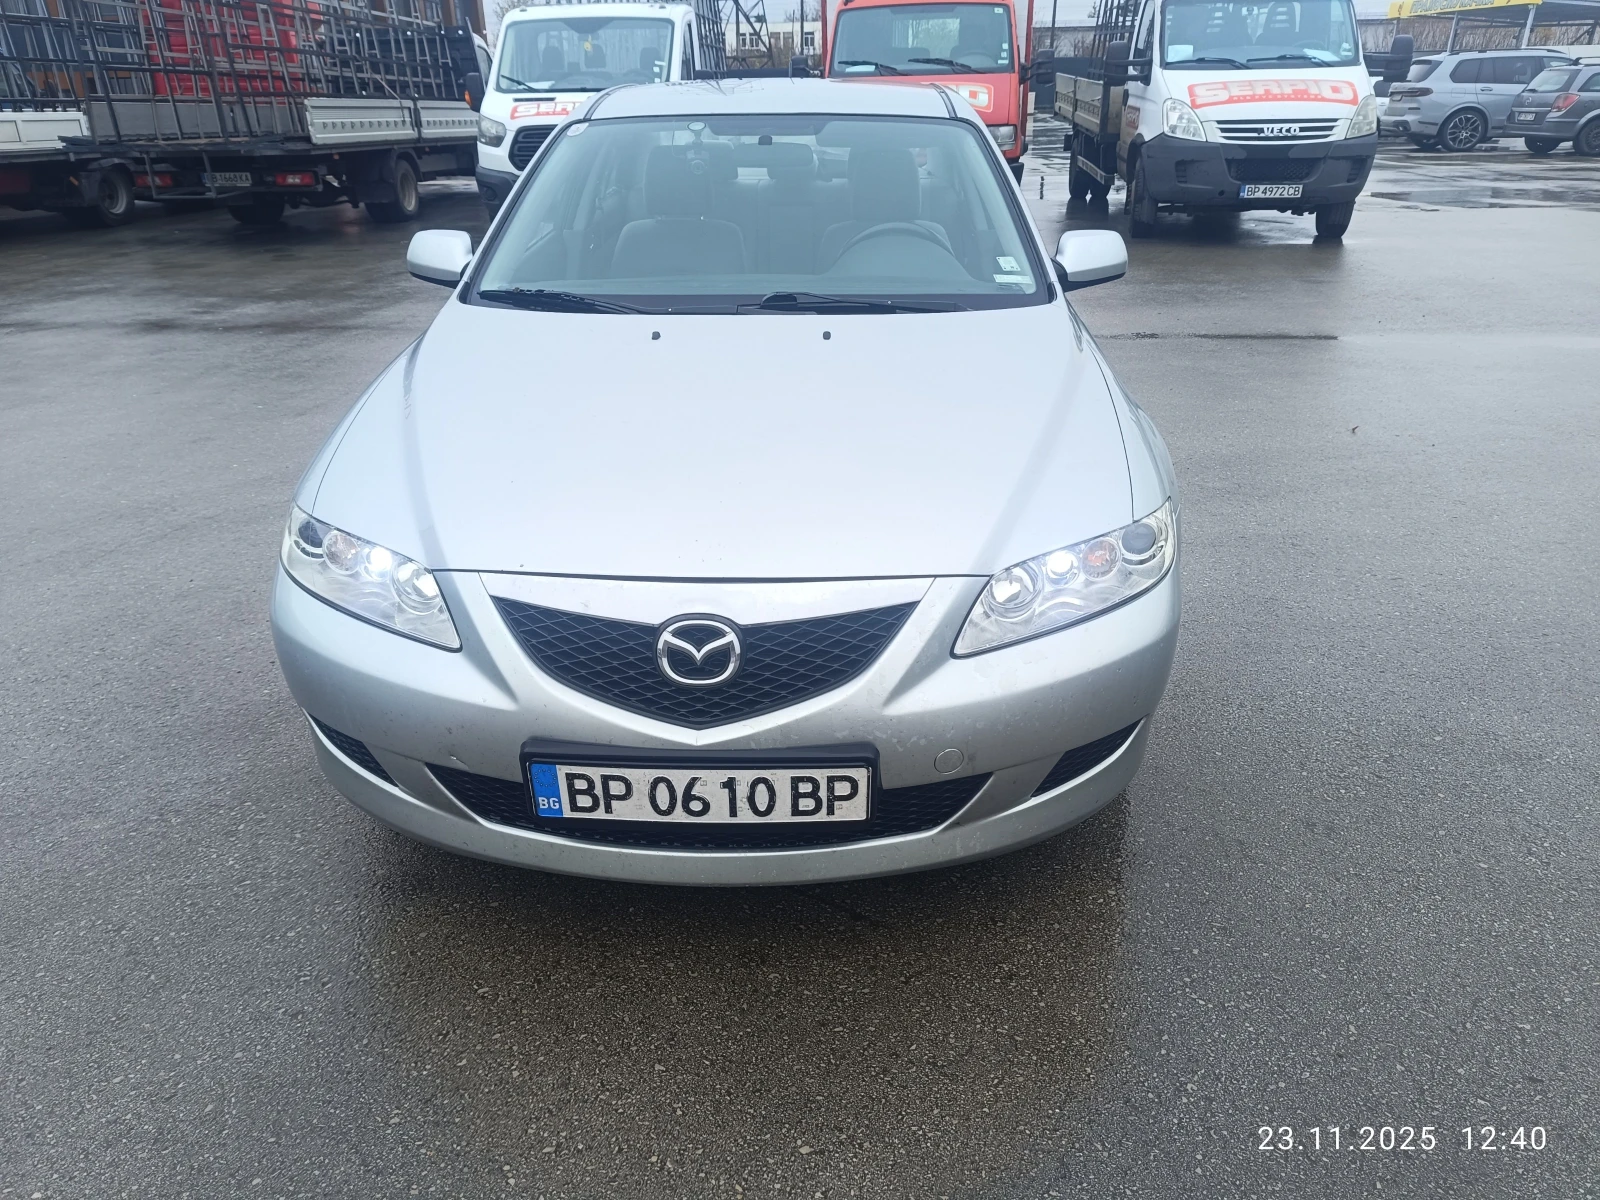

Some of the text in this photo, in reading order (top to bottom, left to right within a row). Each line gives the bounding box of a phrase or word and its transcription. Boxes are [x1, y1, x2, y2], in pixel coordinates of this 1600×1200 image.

[1194, 80, 1354, 105] SERPIO
[1246, 186, 1300, 196] BP 4972 CB
[538, 797, 560, 810] BG
[564, 772, 859, 818] BP 0610 BP
